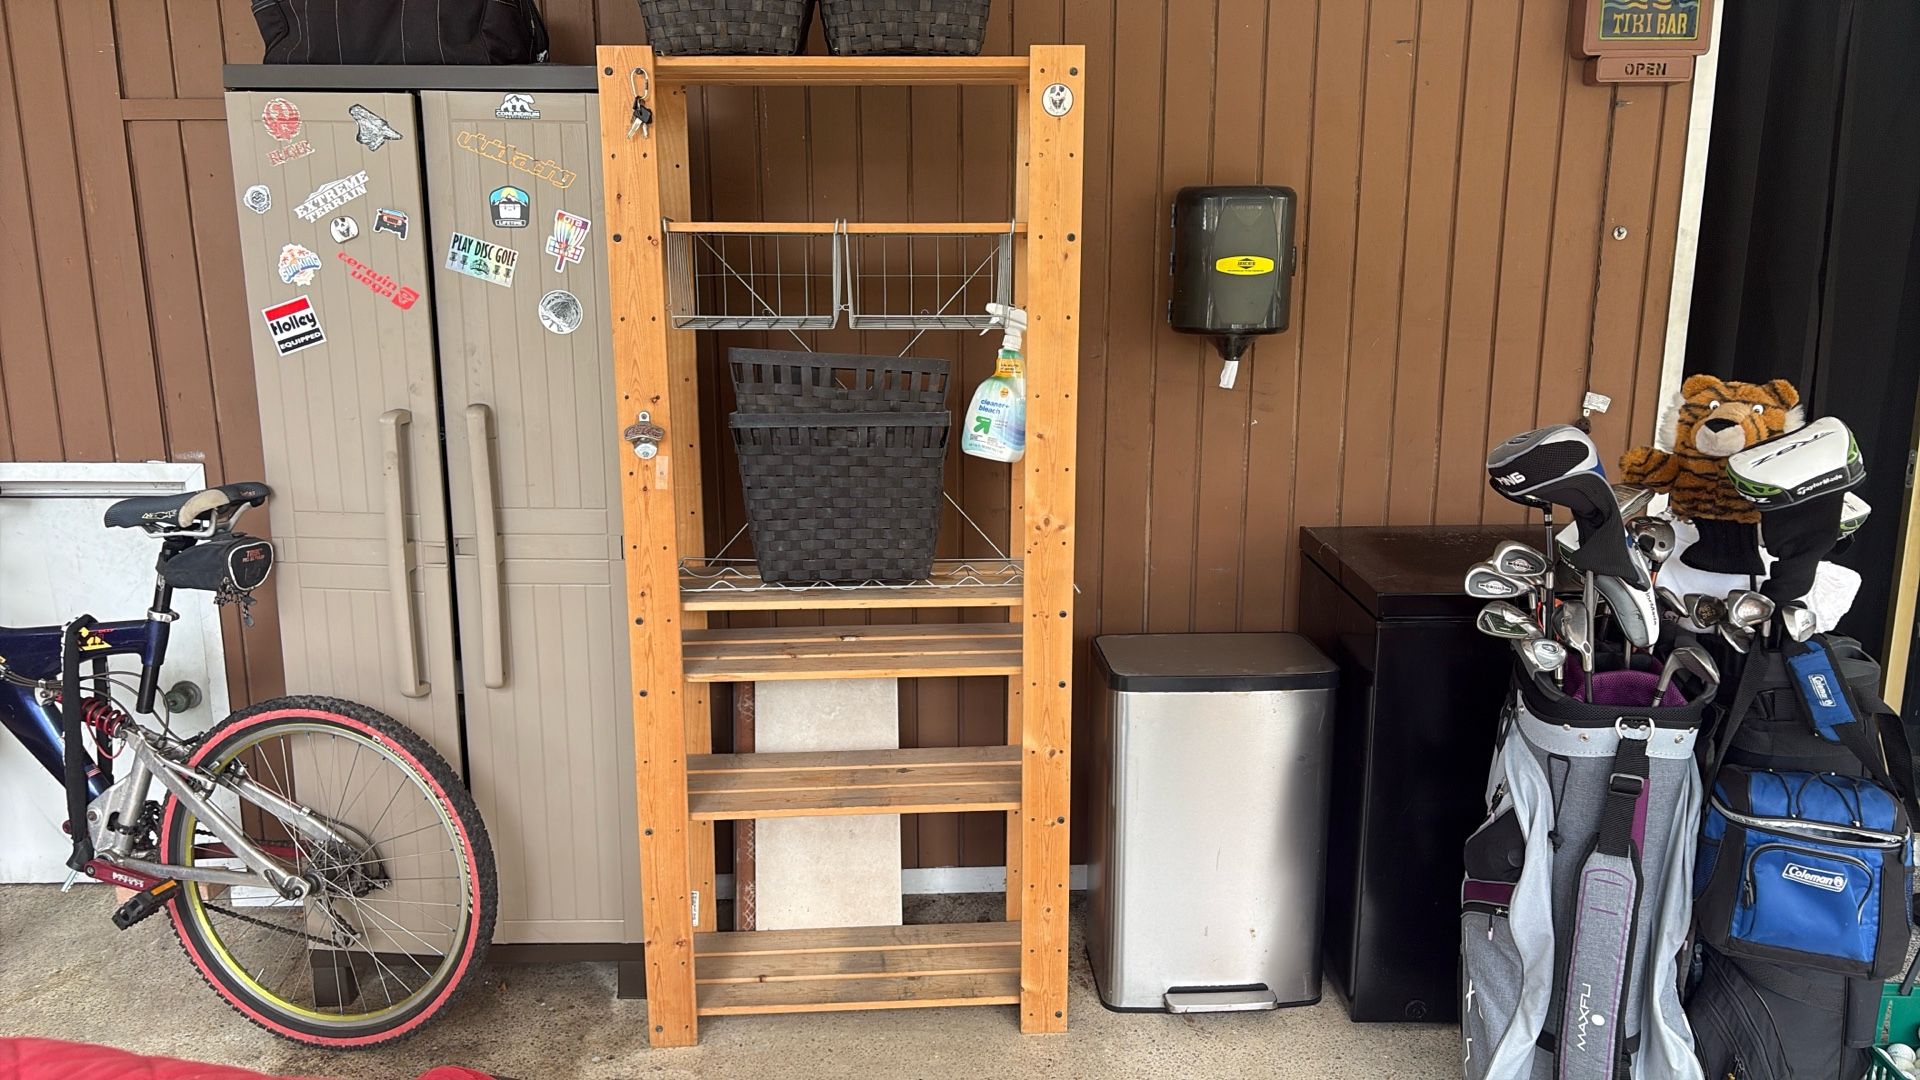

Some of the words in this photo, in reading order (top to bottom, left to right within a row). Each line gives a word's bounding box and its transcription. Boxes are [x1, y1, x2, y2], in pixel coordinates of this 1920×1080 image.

[1613, 13, 1652, 34] TIKI
[1656, 13, 1687, 35] BAR
[1625, 63, 1667, 76] OPEN
[294, 171, 369, 219] EXTREME
[306, 184, 367, 223] TERRAIN
[452, 234, 473, 254] PLAY
[474, 242, 493, 260] DISC
[495, 248, 517, 267] GOLF
[337, 252, 397, 291] cerwin
[271, 313, 316, 335] Holley
[280, 331, 321, 350] EQUIPPED
[1796, 473, 1843, 495] TaylorMade
[1788, 866, 1834, 887] Coleman
